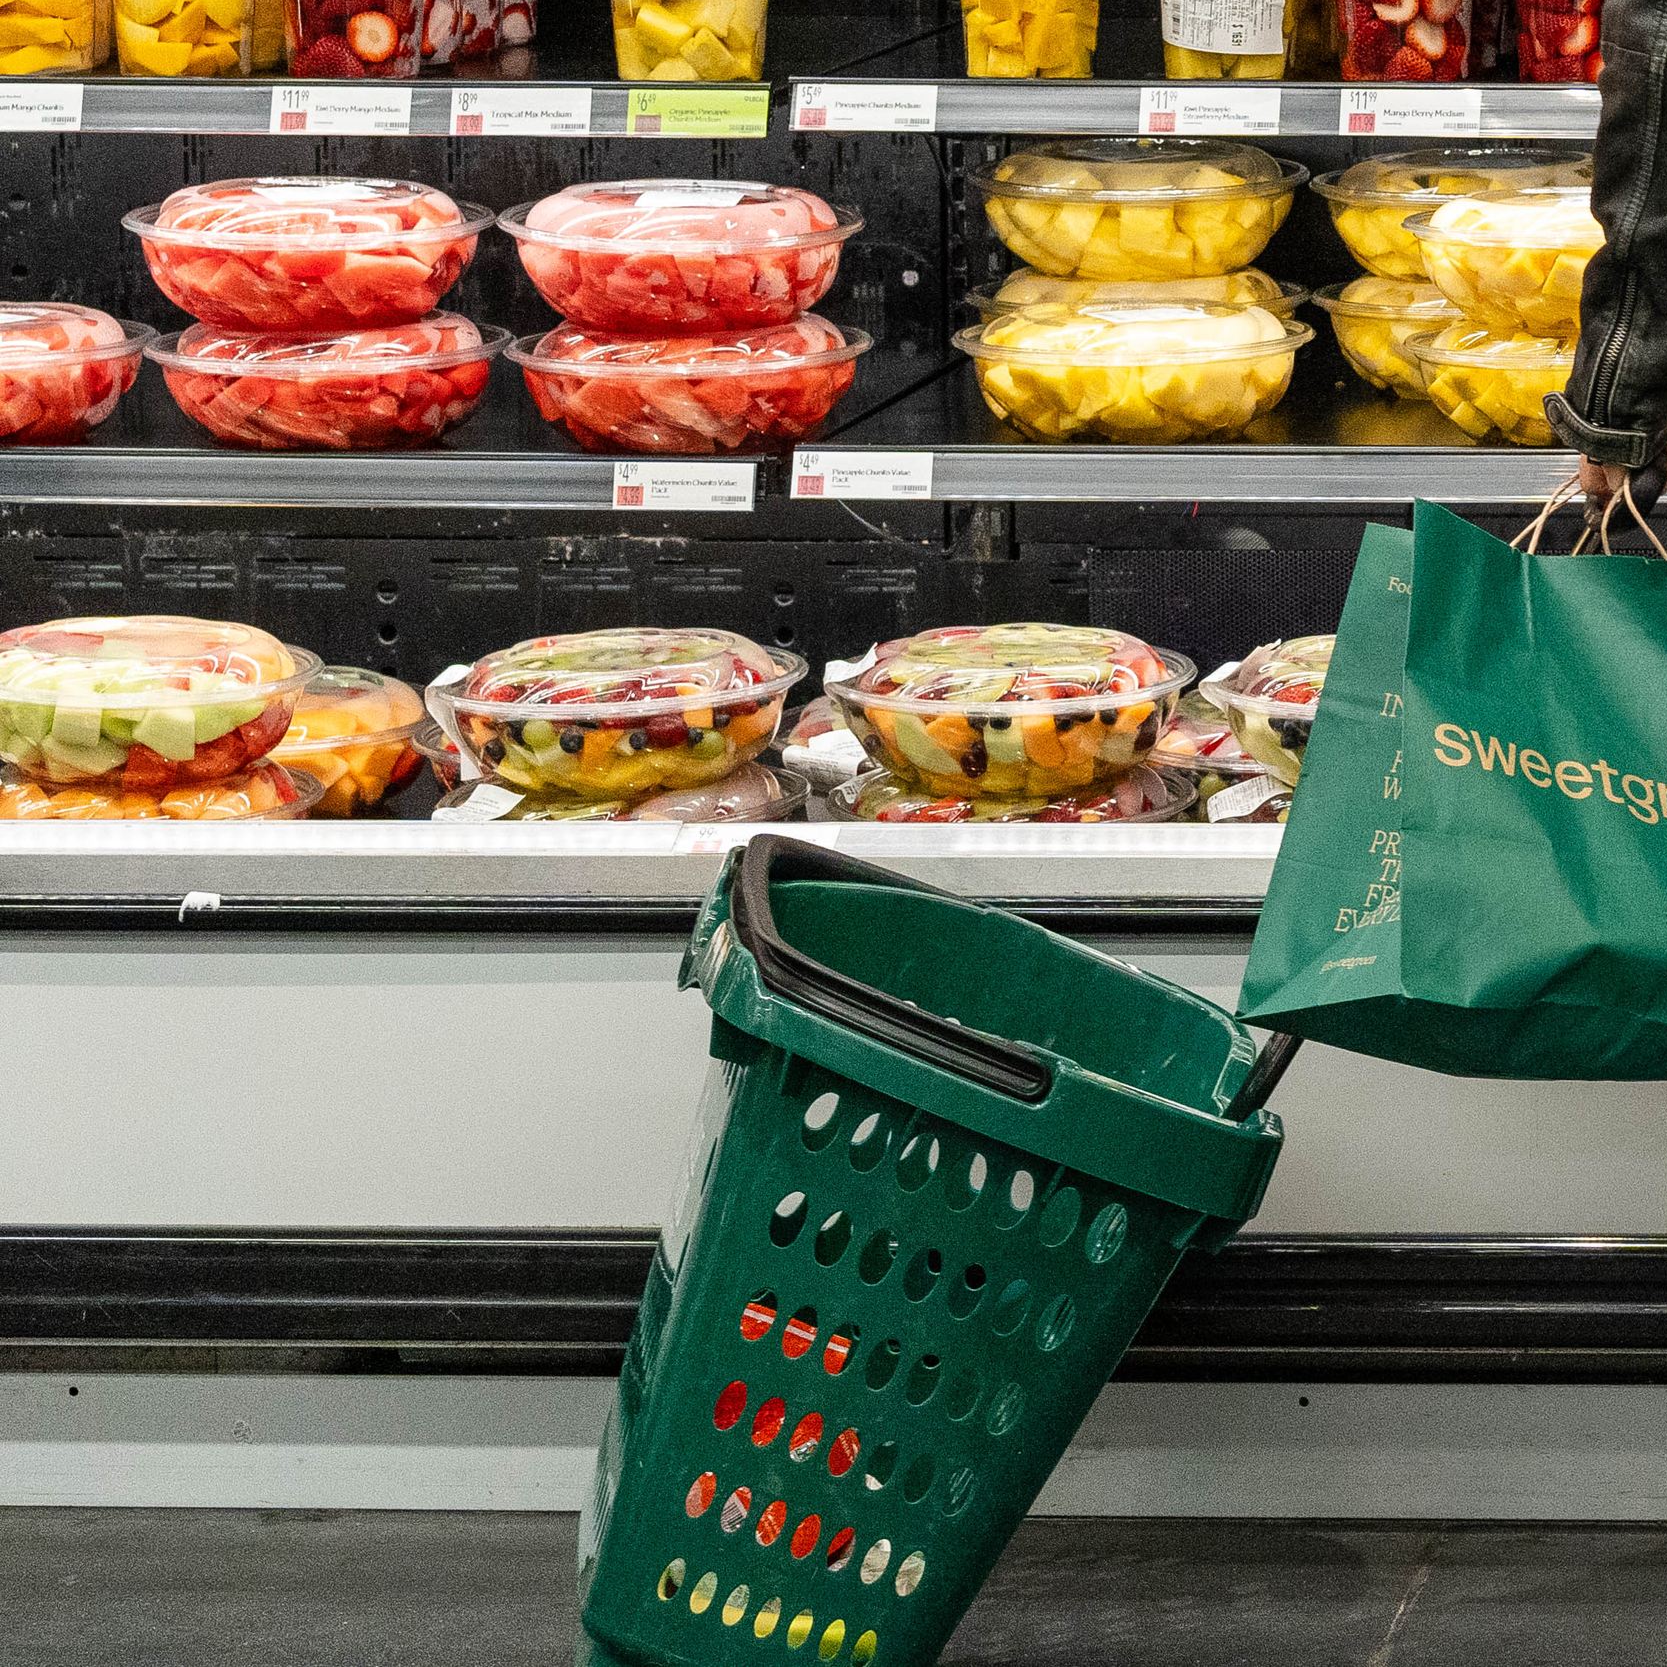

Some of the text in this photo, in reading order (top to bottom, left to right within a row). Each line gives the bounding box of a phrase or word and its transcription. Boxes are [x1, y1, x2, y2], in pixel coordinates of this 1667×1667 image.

[491, 110, 572, 119] Tropical Mix Medium
[1383, 109, 1465, 119] Mango Berry Medium
